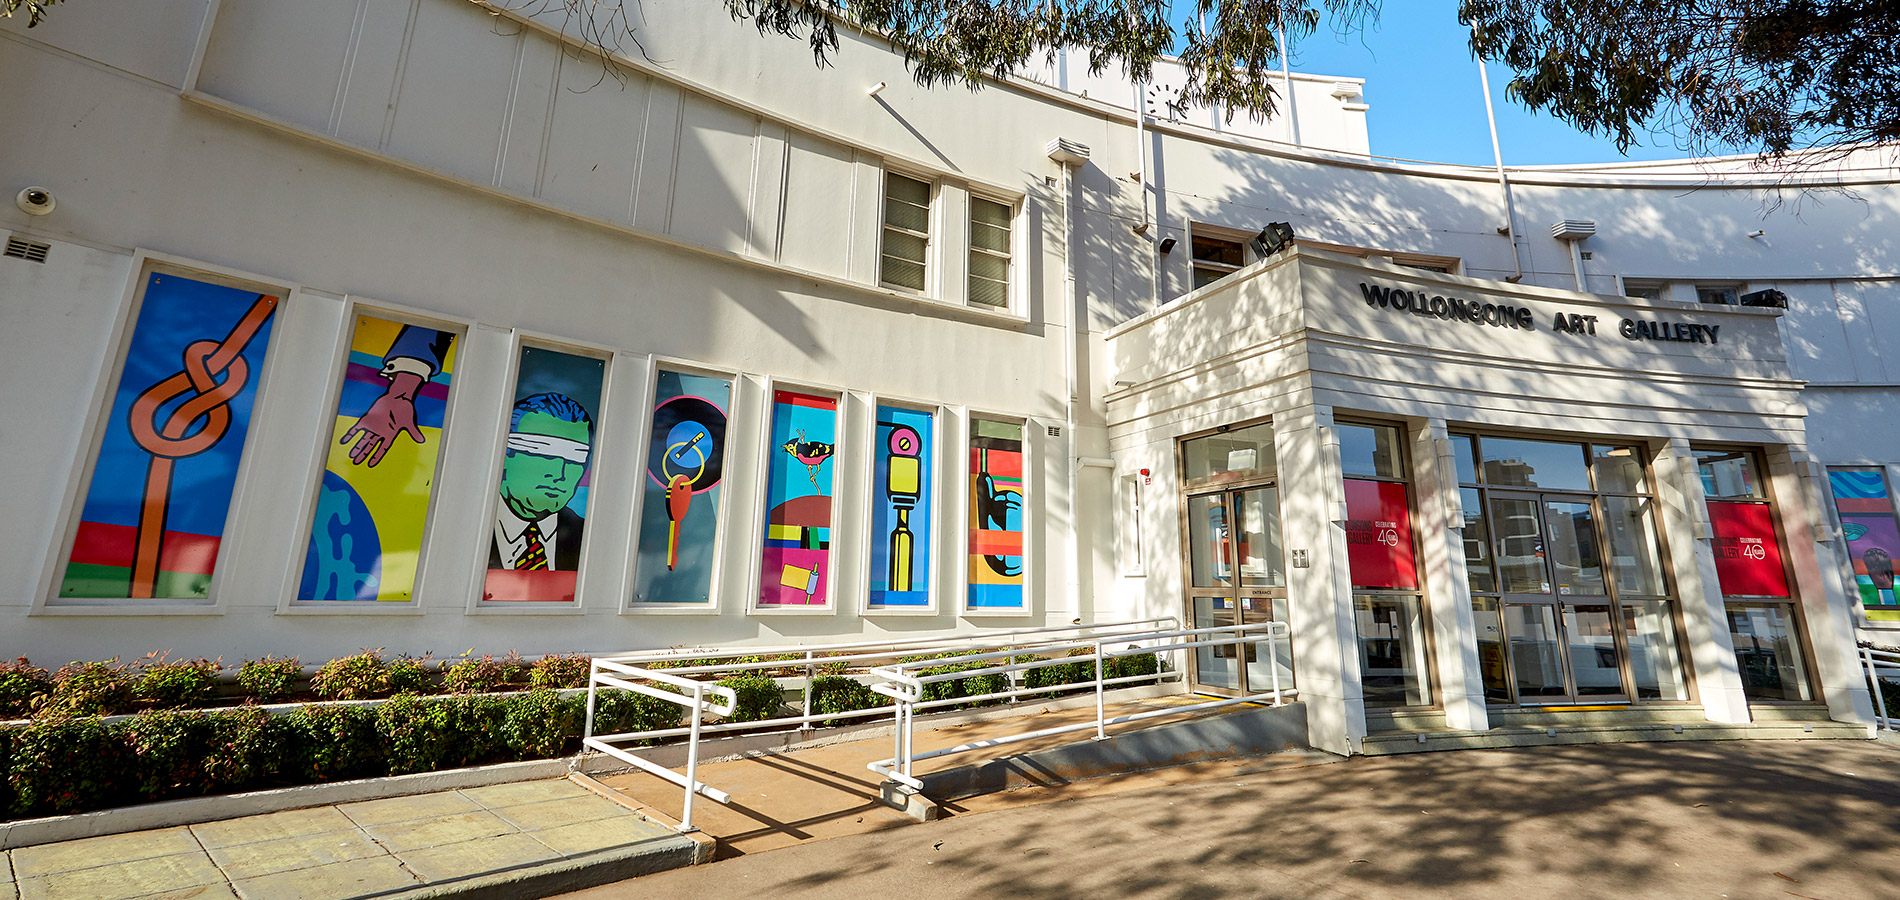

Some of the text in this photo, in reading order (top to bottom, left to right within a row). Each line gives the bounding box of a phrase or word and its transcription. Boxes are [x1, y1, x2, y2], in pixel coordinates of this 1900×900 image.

[1360, 283, 1720, 344] WOLLONGONG ART GALLERY
[1348, 532, 1373, 544] GALLERY
[1378, 529, 1398, 546] 40
[1744, 544, 1765, 560] 40
